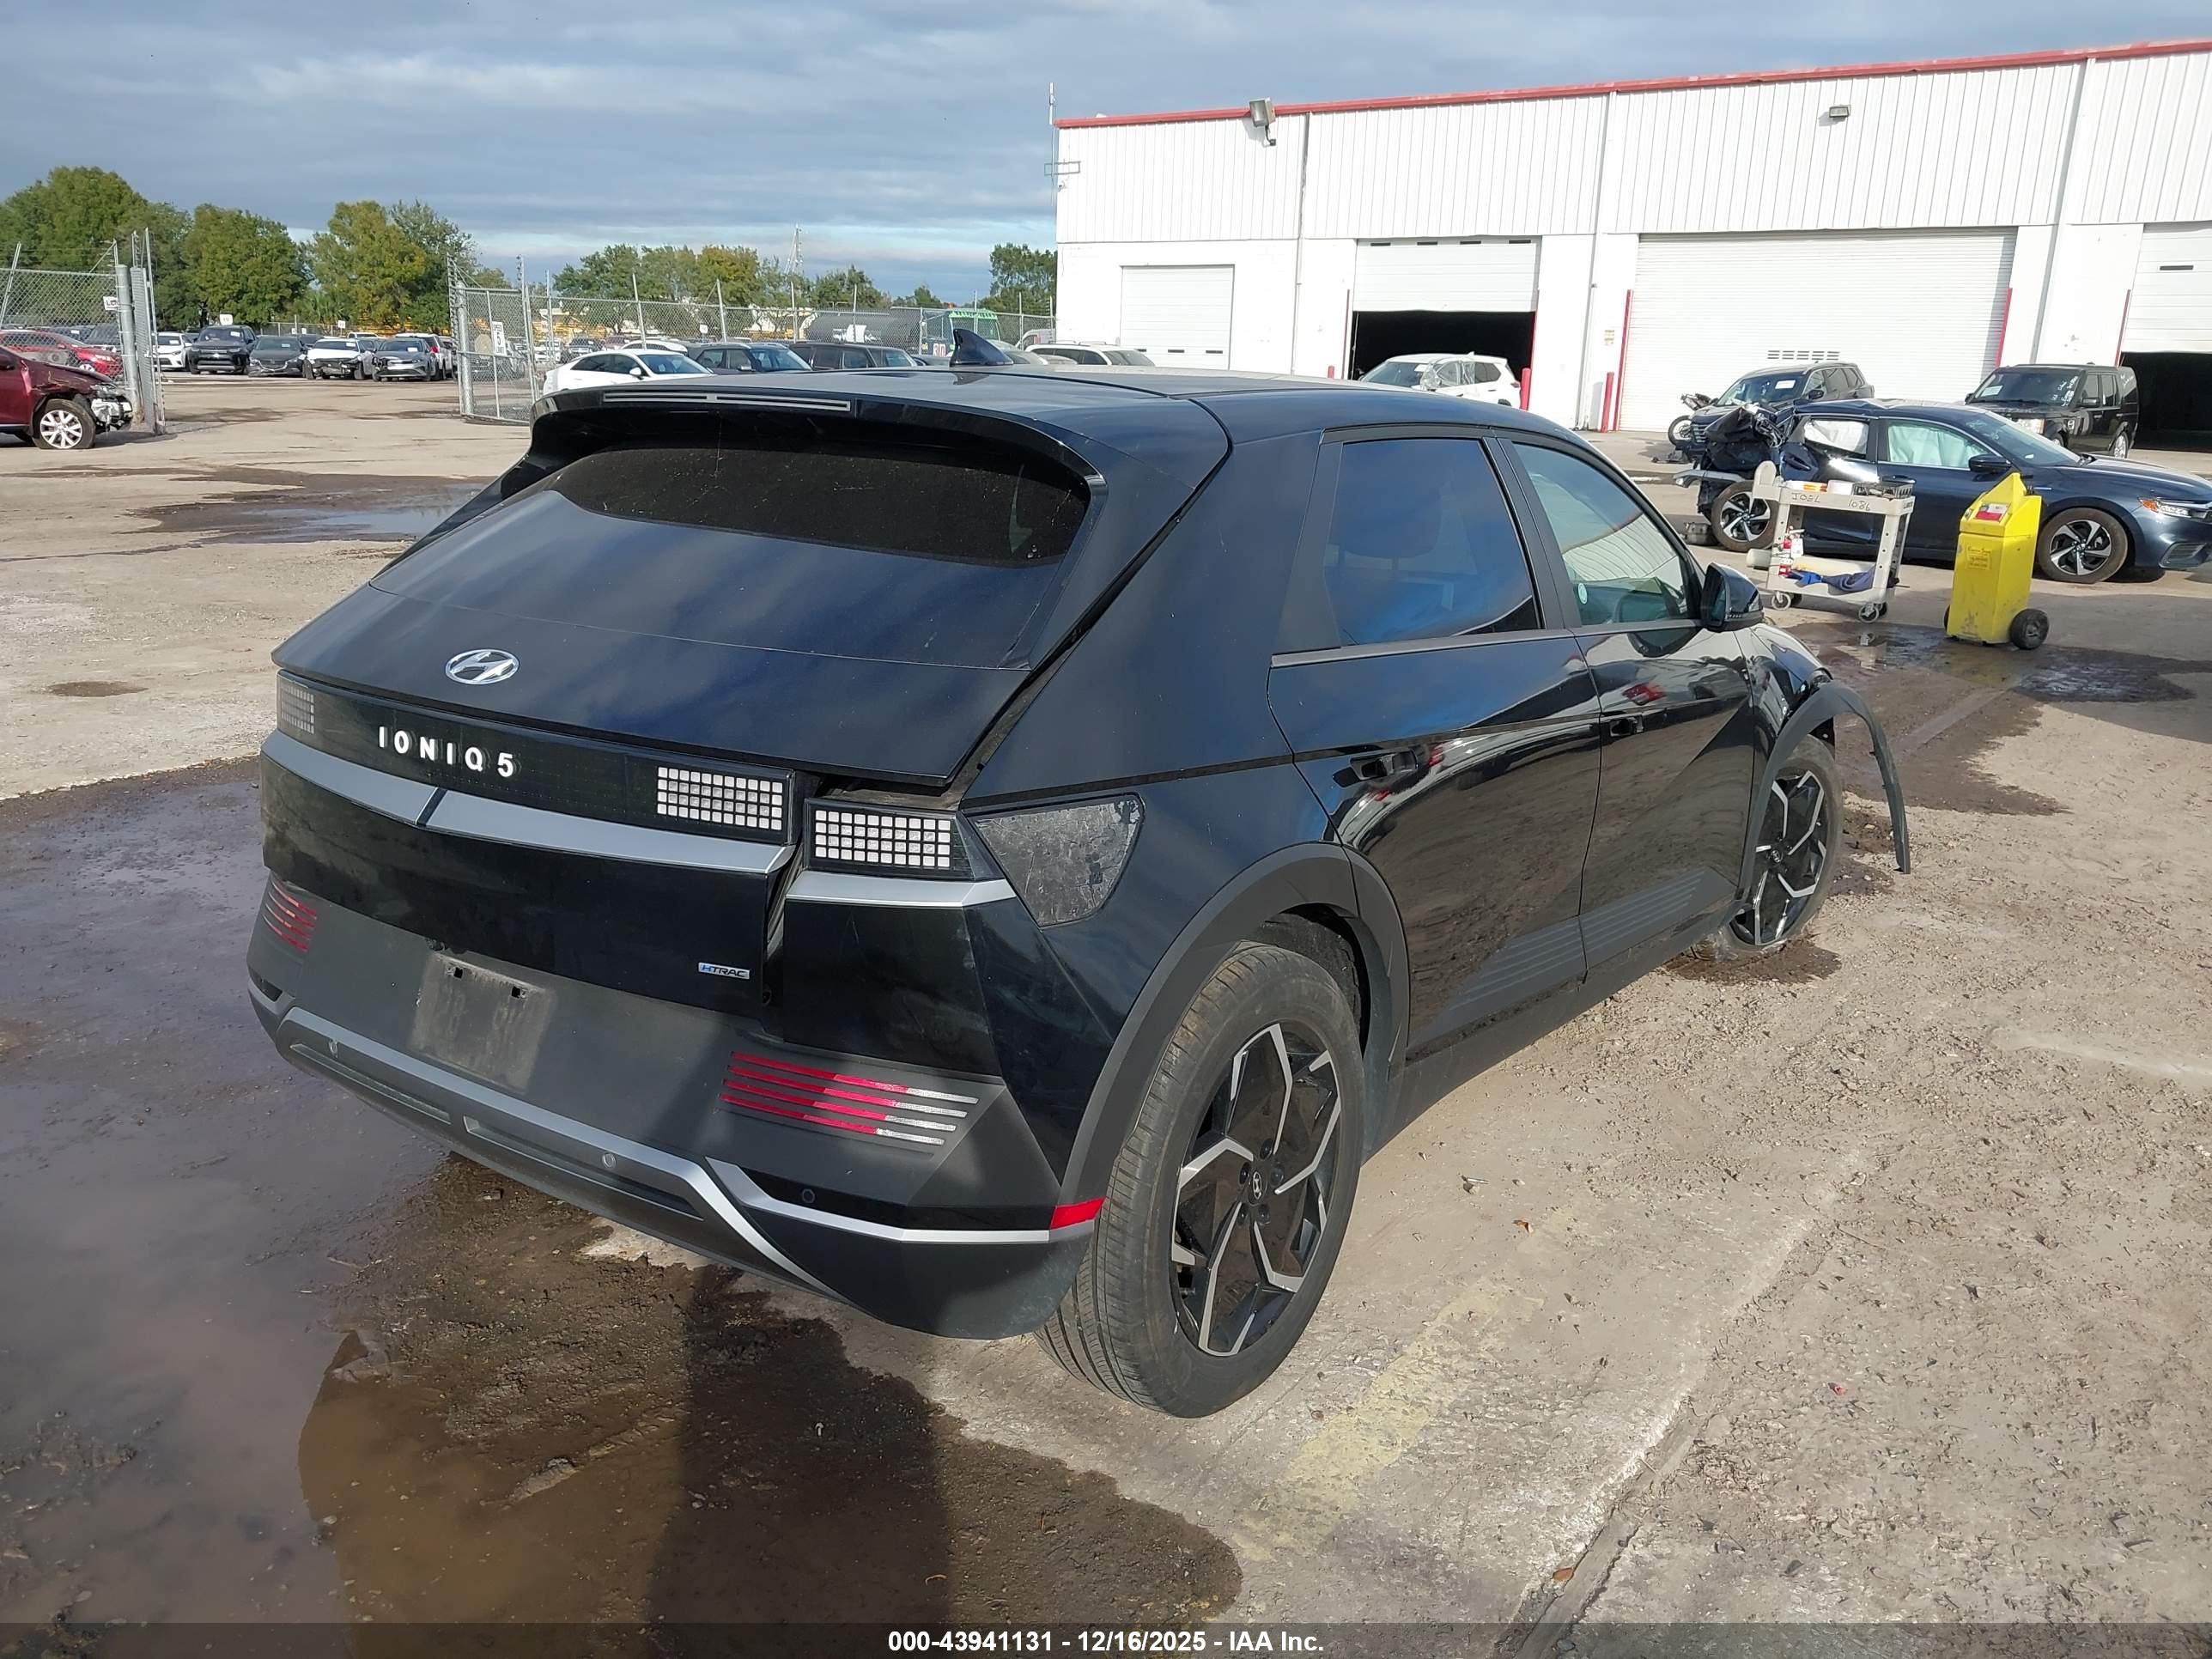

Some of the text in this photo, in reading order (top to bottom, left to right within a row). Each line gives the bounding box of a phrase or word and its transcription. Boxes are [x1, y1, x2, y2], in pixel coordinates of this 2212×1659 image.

[379, 726, 514, 778] IONIQ 5
[700, 964, 747, 977] HTRAC
